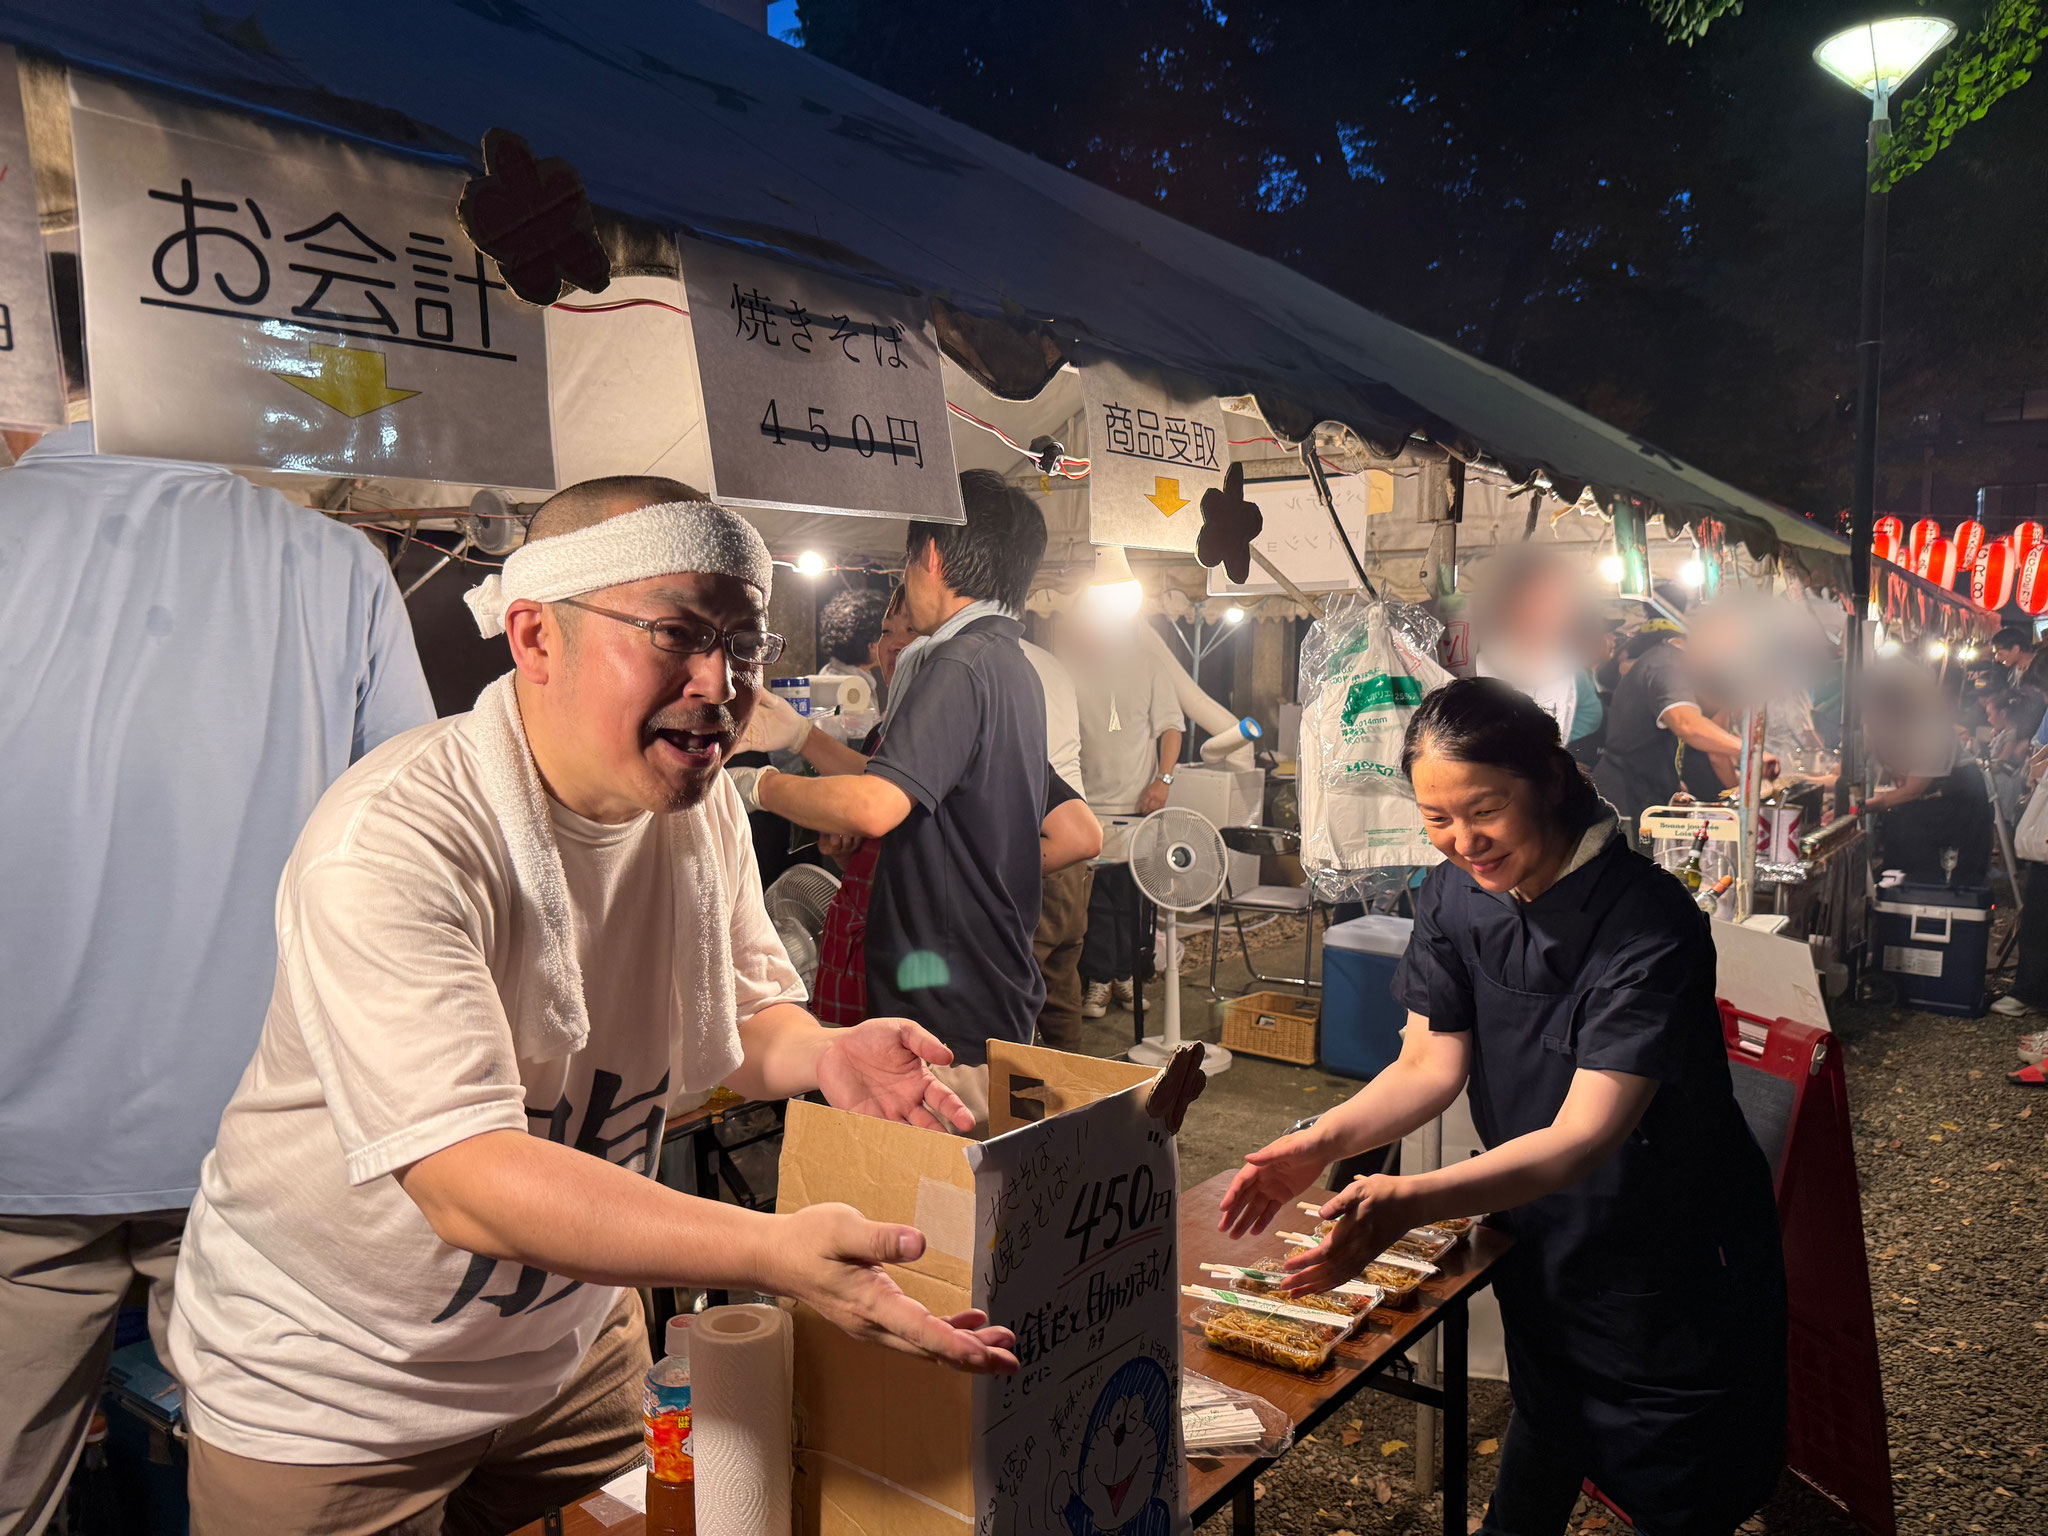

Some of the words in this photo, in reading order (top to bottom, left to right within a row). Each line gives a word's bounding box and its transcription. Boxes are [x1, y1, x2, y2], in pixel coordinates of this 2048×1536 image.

[148, 178, 508, 349] お会計
[731, 283, 908, 370] 焼きそば
[760, 399, 924, 470] 450円
[1103, 401, 1220, 469] 商品受取
[985, 1127, 1055, 1233] やきそば
[1063, 1163, 1173, 1266] 450円
[996, 1244, 1173, 1384] 銭だと助かります!
